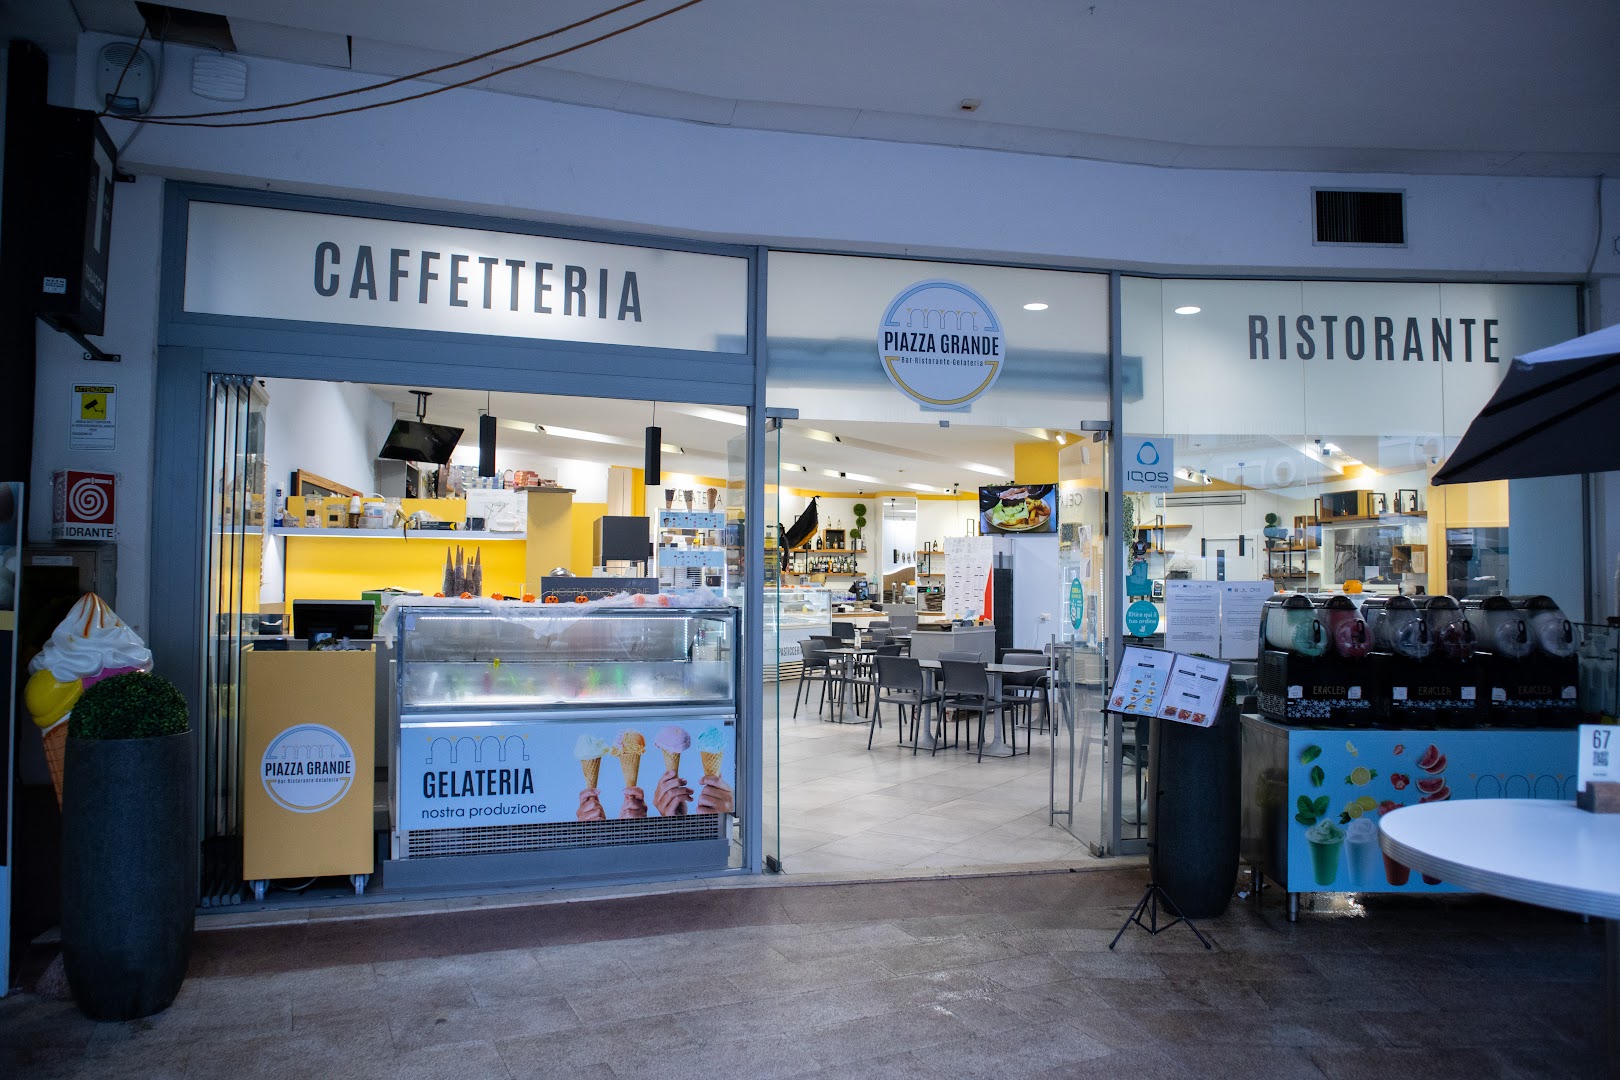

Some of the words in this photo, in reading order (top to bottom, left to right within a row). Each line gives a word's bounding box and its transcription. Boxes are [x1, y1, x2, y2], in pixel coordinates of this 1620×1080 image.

[313, 241, 642, 322] CAFFETTERIA
[884, 331, 936, 353] PIAZZA
[940, 334, 999, 356] GRANDE
[1248, 314, 1500, 363] RISTORANTE
[1127, 470, 1169, 483] IQOS
[66, 527, 114, 538] IDRANTE
[551, 587, 589, 597] NOSTRA
[1313, 685, 1346, 695] ERACLEA
[1418, 686, 1451, 696] ERACLEA
[1518, 685, 1552, 695] ERACLEA
[1593, 729, 1611, 749] 67
[265, 762, 304, 776] PIAZZA
[307, 760, 351, 775] GRANDE
[423, 768, 534, 799] GELATERIA
[421, 806, 465, 819] nostra
[469, 802, 547, 819] produzione
